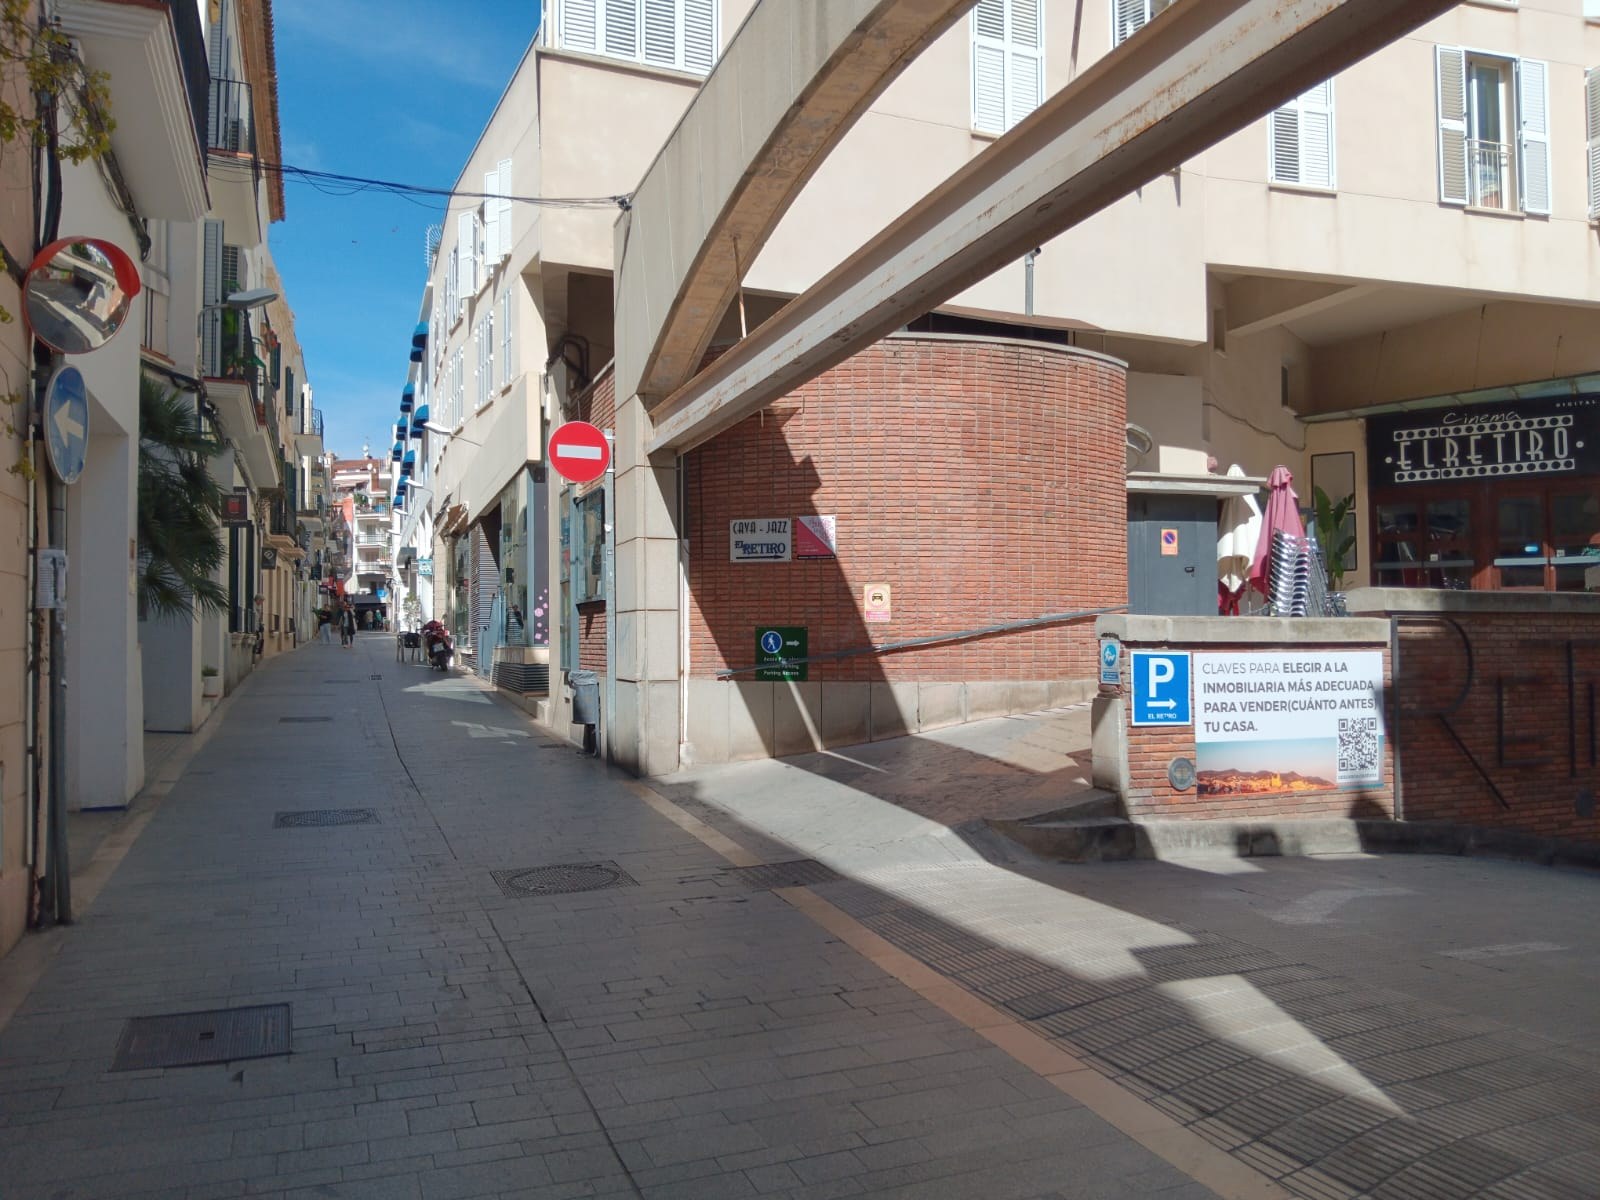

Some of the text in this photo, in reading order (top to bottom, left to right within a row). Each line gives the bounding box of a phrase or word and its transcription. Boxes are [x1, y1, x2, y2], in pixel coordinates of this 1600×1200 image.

[1442, 411, 1522, 424] Cinema
[1397, 427, 1569, 470] EL RETIRO
[766, 520, 787, 534] JAZZ
[742, 542, 786, 555] RETIRO
[1202, 662, 1348, 675] CLAVES PARA ELEGIR A LA
[1148, 657, 1175, 698] P
[1203, 678, 1374, 694] INMOBILIARIA MÁS ADECUADA
[1204, 701, 1237, 713] PARA
[1339, 698, 1377, 710] ANTES)
[1203, 720, 1258, 733] TU CASA.
